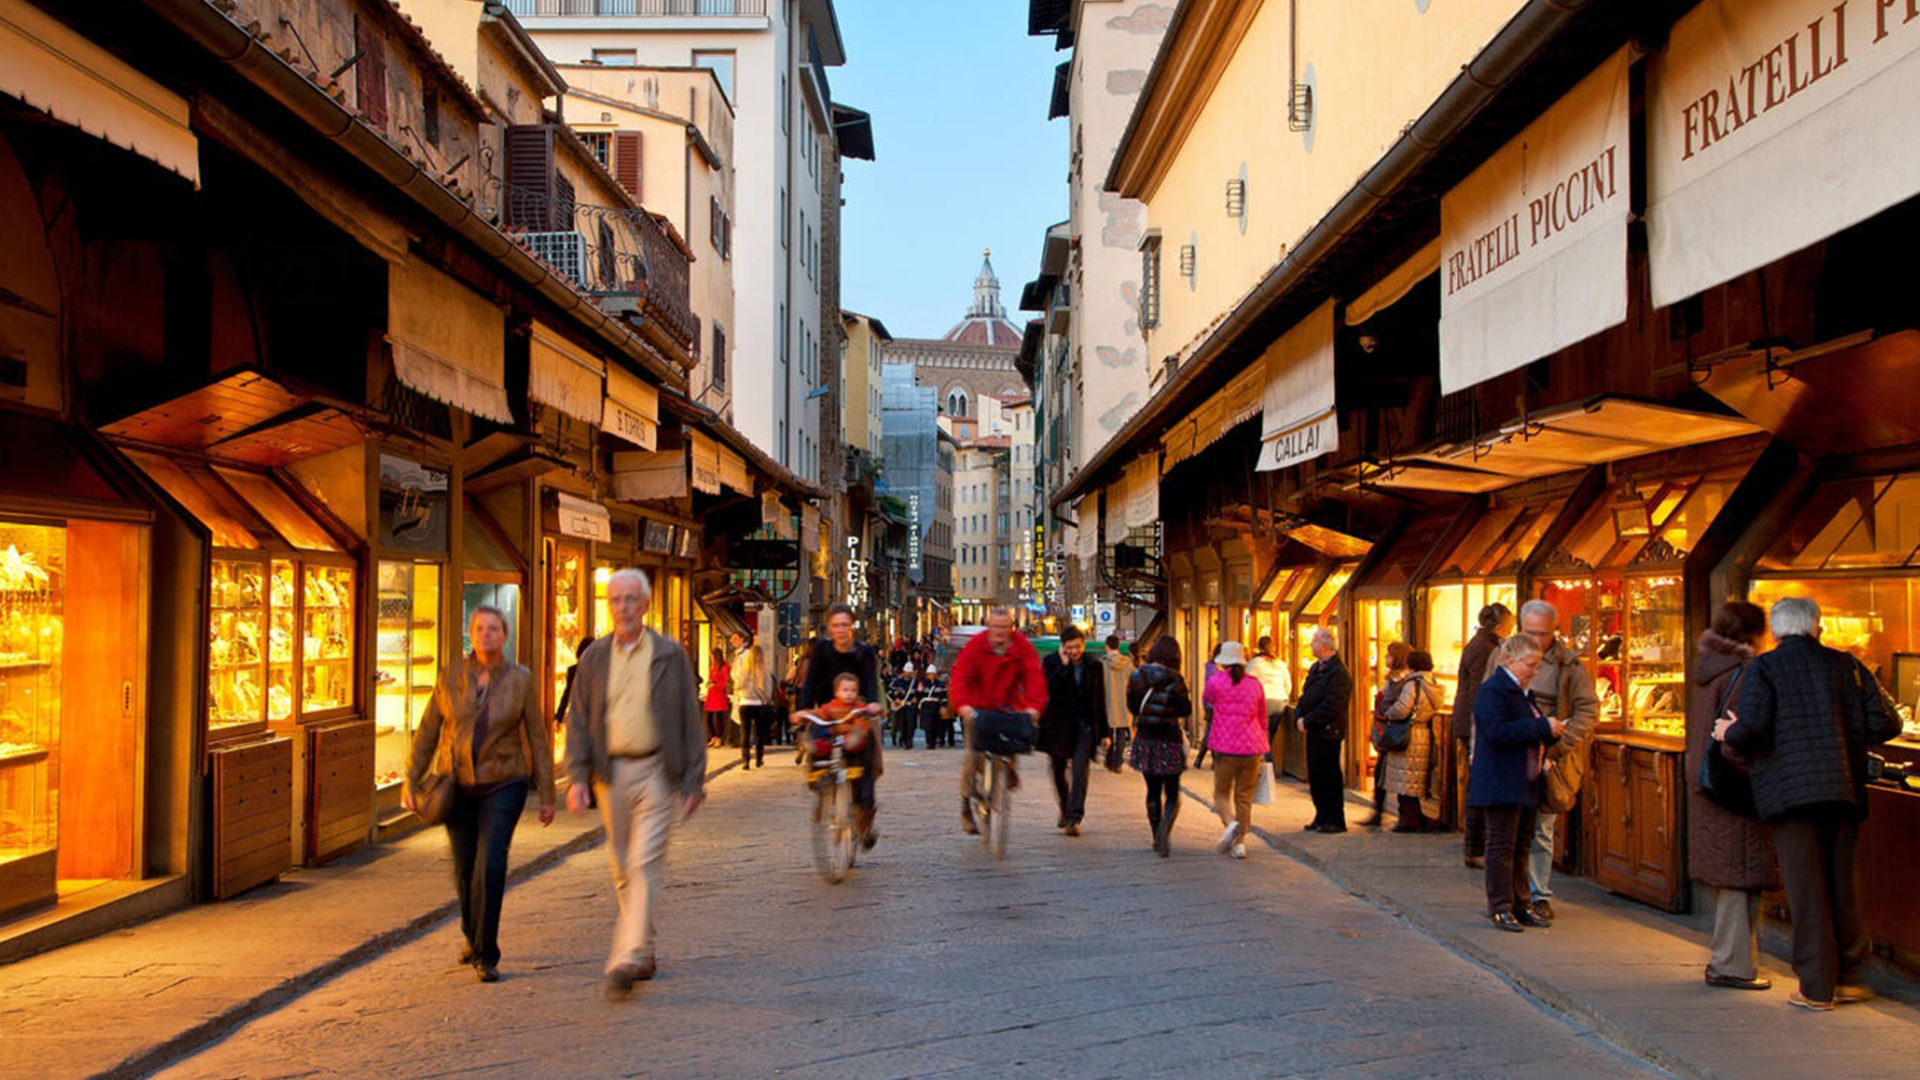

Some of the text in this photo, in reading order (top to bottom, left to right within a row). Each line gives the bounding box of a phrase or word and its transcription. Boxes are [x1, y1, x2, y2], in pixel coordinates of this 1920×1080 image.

[1681, 0, 1848, 161] FRATELLI
[1448, 144, 1617, 296] FRATELLI PICCINI
[1275, 423, 1320, 463] CALLAI
[1036, 525, 1044, 604] RISTORANTE
